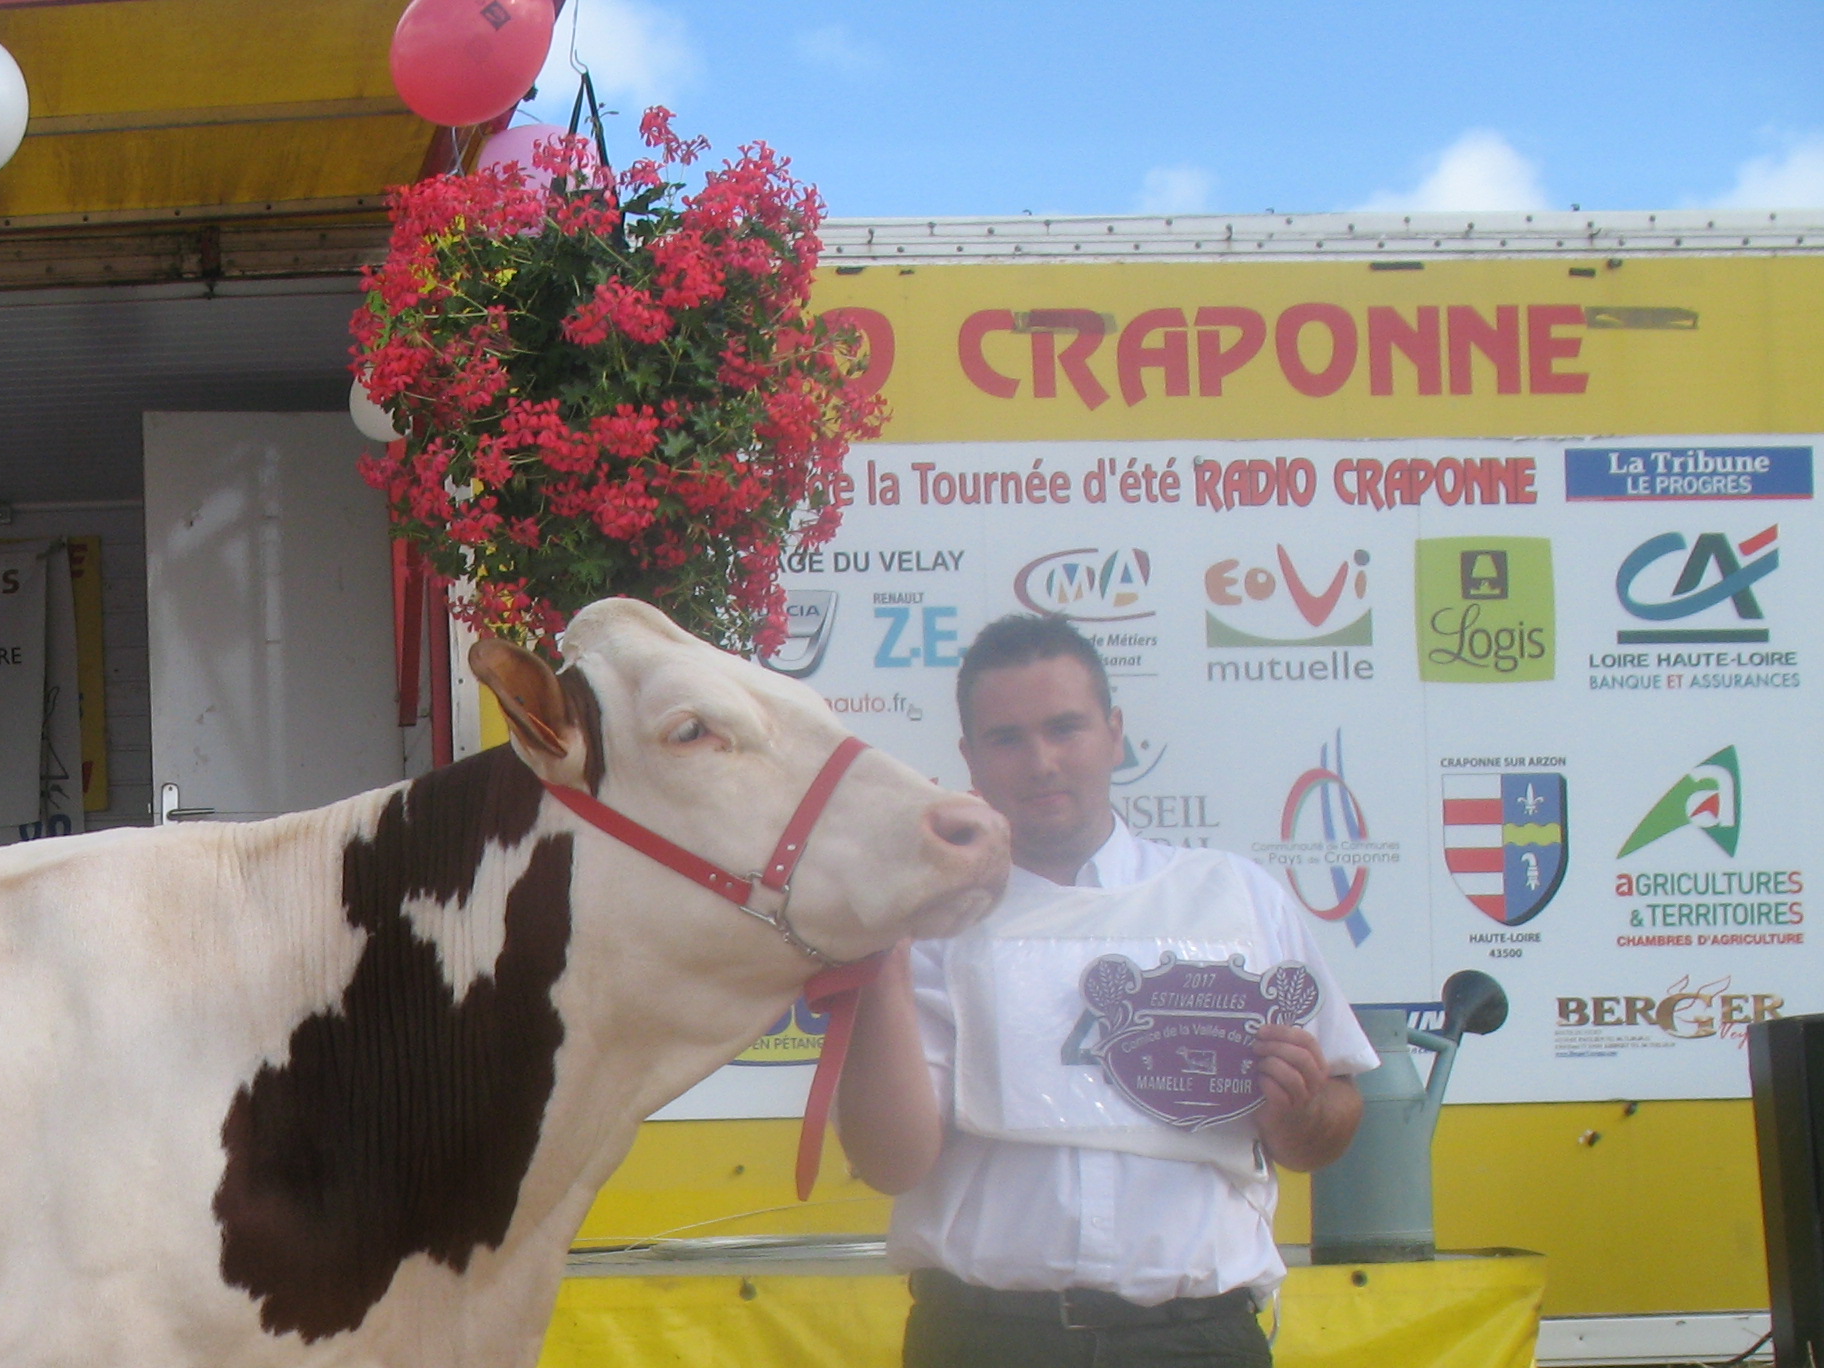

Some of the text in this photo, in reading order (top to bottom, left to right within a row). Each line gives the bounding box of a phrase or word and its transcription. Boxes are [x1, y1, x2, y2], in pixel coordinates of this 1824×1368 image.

[958, 304, 1590, 411] CRAPONNE
[1608, 450, 1770, 474] La Tribune
[867, 460, 900, 505] la
[911, 458, 1071, 505] Tournée
[1083, 457, 1180, 505] d'été
[1194, 456, 1317, 512] RADIO
[1333, 456, 1538, 512] CRAPONNE
[1627, 475, 1752, 494] LE PROGRES
[775, 550, 965, 573] AGE DU VELAY
[873, 592, 924, 605] RENAULT
[757, 605, 820, 617] DCIA
[1107, 634, 1157, 647] Métiers
[1429, 604, 1546, 672] Logis
[1101, 655, 1142, 667] isanat
[1208, 651, 1375, 681] mutuelle
[1589, 651, 1798, 668] LOIRE HAUTE-LOIRE
[1589, 672, 1800, 690] BANQUE ET ASSURANCES
[1440, 756, 1567, 768] CRAPONNE SUR ARZON
[1122, 795, 1220, 829] SEIL
[1268, 853, 1302, 866] Pays
[1324, 852, 1400, 866] Craponne
[1630, 902, 1804, 927] & TERRITOIRES
[1469, 933, 1541, 944] HAUTE-LOIRE
[1617, 933, 1804, 947] CHAMBRES D'AGRICULTURE
[1489, 949, 1523, 959] 43500
[1183, 973, 1217, 988] 2017
[1150, 992, 1247, 1009] ESTIVAREILLES
[1557, 991, 1785, 1038] BERGER
[1136, 1075, 1253, 1094] MAMELLE ESPOIR
